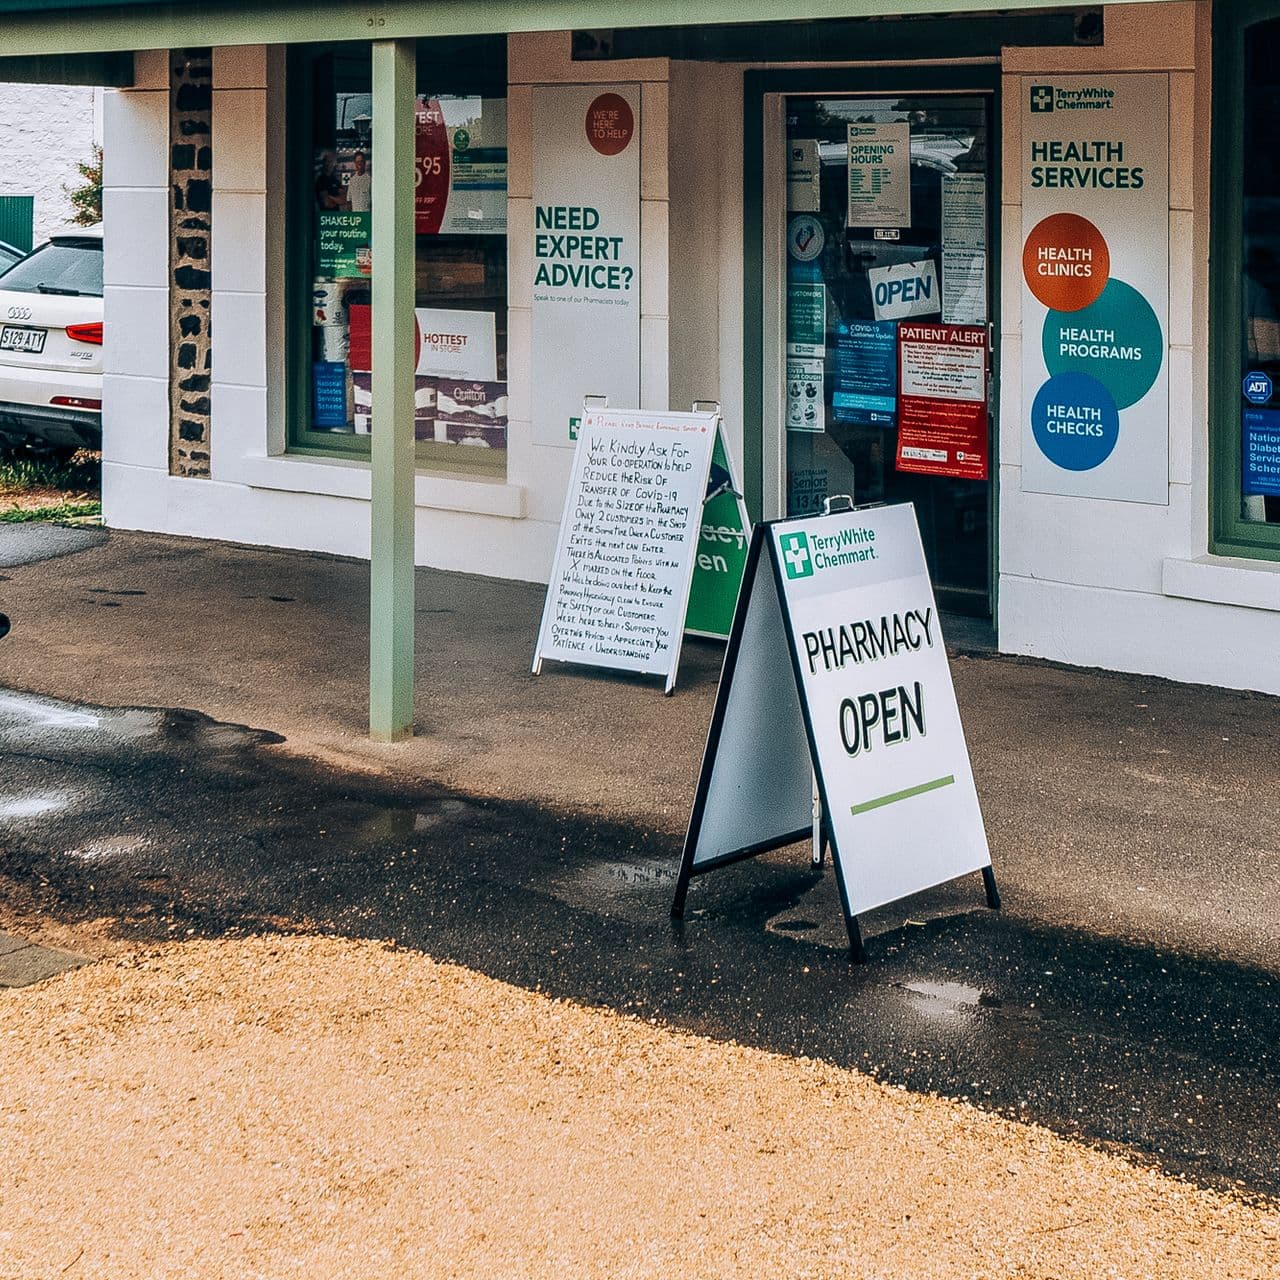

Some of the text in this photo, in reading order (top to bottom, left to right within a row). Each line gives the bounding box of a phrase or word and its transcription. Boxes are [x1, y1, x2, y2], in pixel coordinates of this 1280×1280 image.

[1056, 88, 1114, 100] TerryWhite
[593, 111, 619, 120] WE'RE
[593, 120, 615, 129] HERE
[593, 130, 627, 139] TO HELP
[851, 146, 894, 154] OPENING
[1032, 142, 1123, 162] HEALTH
[851, 155, 883, 164] HOURS
[1031, 167, 1144, 188] SERVICES
[536, 206, 599, 230] NEED
[320, 229, 367, 240] your routine
[536, 235, 623, 260] EXPERT
[1038, 247, 1092, 261] HEALTH
[534, 263, 633, 290] ADVICE?
[1038, 263, 1092, 277] CLINICS
[874, 275, 931, 306] OPEN
[424, 334, 468, 345] HOTTEST
[900, 328, 985, 343] PATIENT ALERT
[1060, 328, 1114, 342] HEALTH
[441, 345, 462, 353] STORE
[1060, 344, 1142, 360] PROGRAMS
[454, 387, 486, 402] Quilton
[1248, 382, 1267, 392] ADT
[1047, 405, 1101, 420] HEALTH
[1047, 421, 1103, 436] CHECKS
[810, 528, 875, 551] TerryWhite
[802, 607, 933, 675] PHARMACY
[839, 681, 925, 757] OPEN
